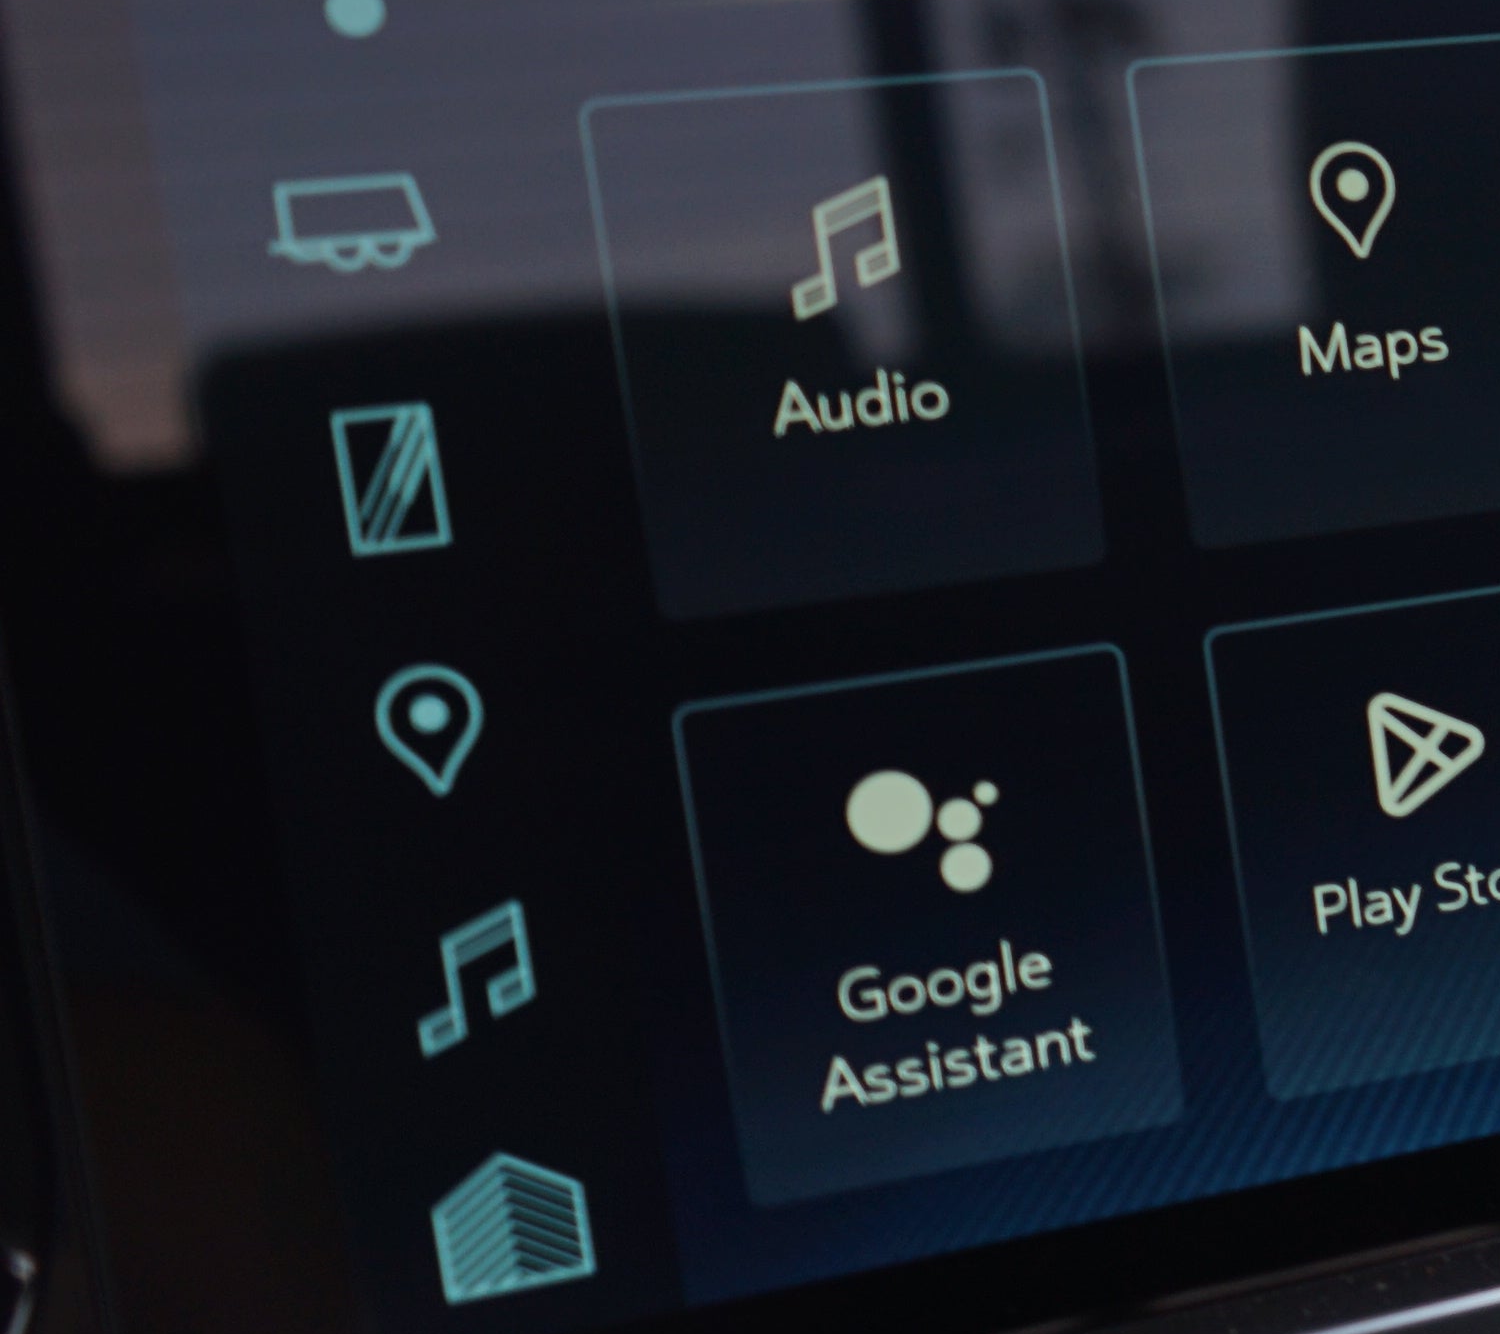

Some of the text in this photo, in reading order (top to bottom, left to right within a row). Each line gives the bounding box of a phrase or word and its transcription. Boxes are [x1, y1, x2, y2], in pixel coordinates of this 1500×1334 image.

[1297, 321, 1449, 379] Maps
[773, 367, 950, 438] Audio
[1311, 874, 1421, 935] Play
[836, 939, 1053, 1023] Google
[819, 1016, 1095, 1114] Assistant
